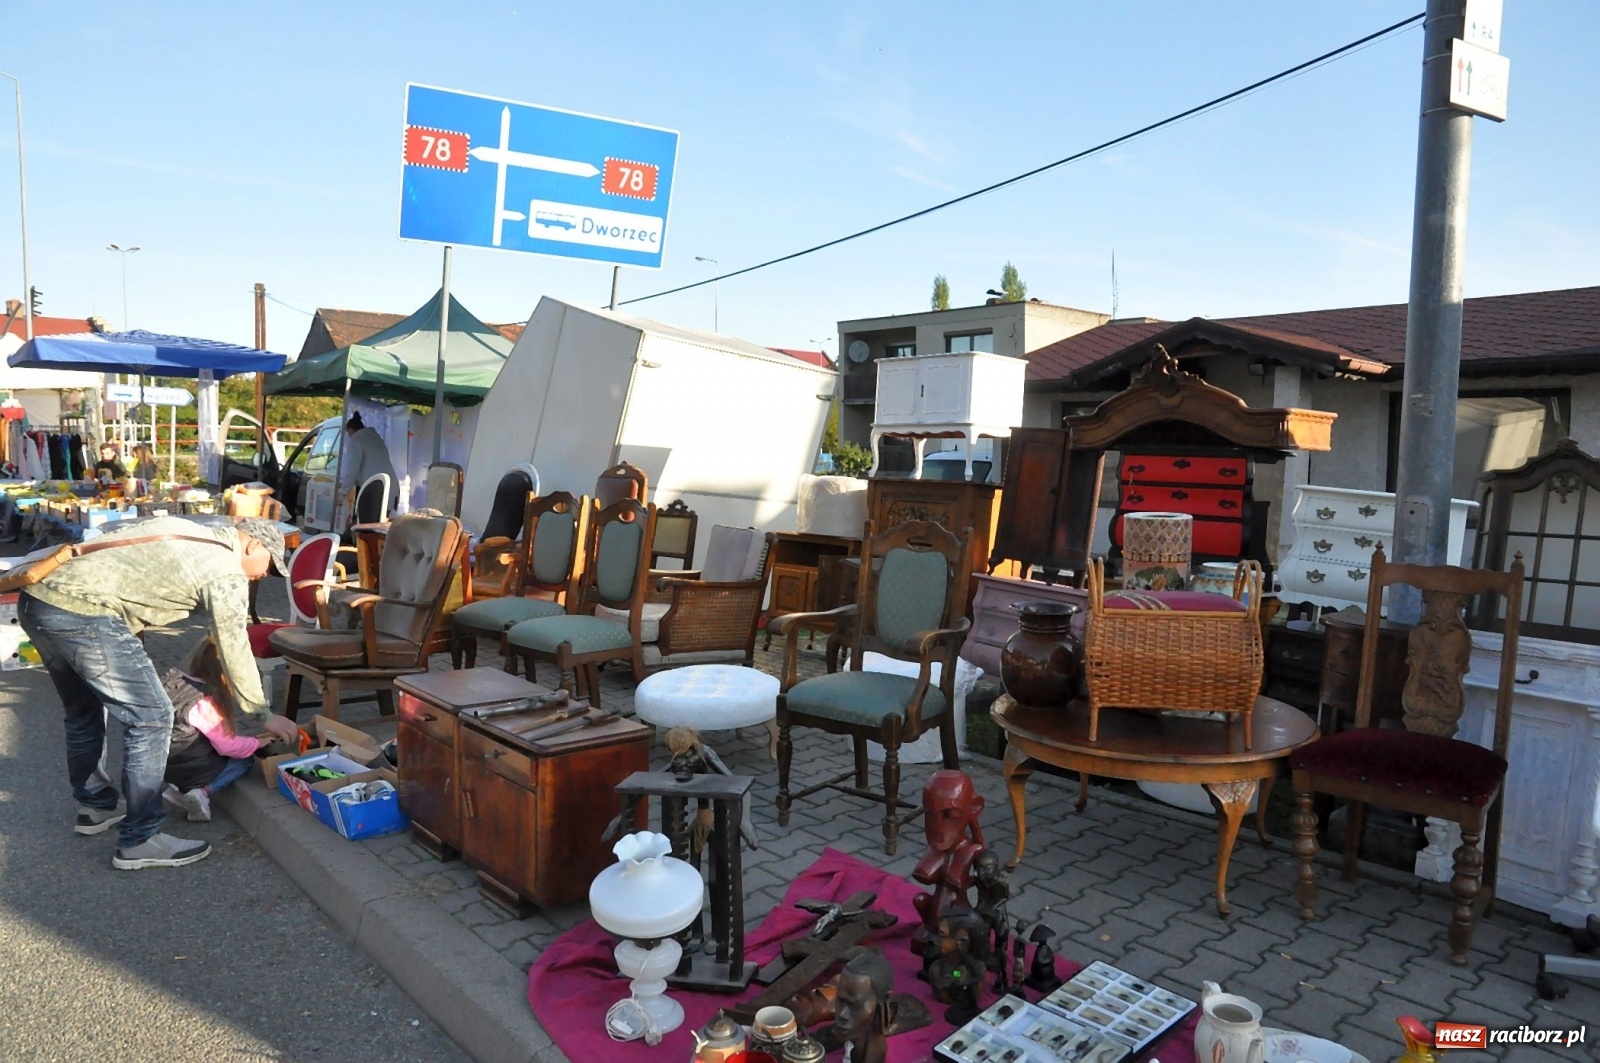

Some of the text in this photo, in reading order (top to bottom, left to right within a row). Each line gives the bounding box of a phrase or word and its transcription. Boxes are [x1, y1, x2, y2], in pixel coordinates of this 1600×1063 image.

[420, 136, 451, 162] 78
[618, 167, 644, 191] 78
[581, 217, 657, 243] Dworzec
[140, 391, 181, 402] worzec
